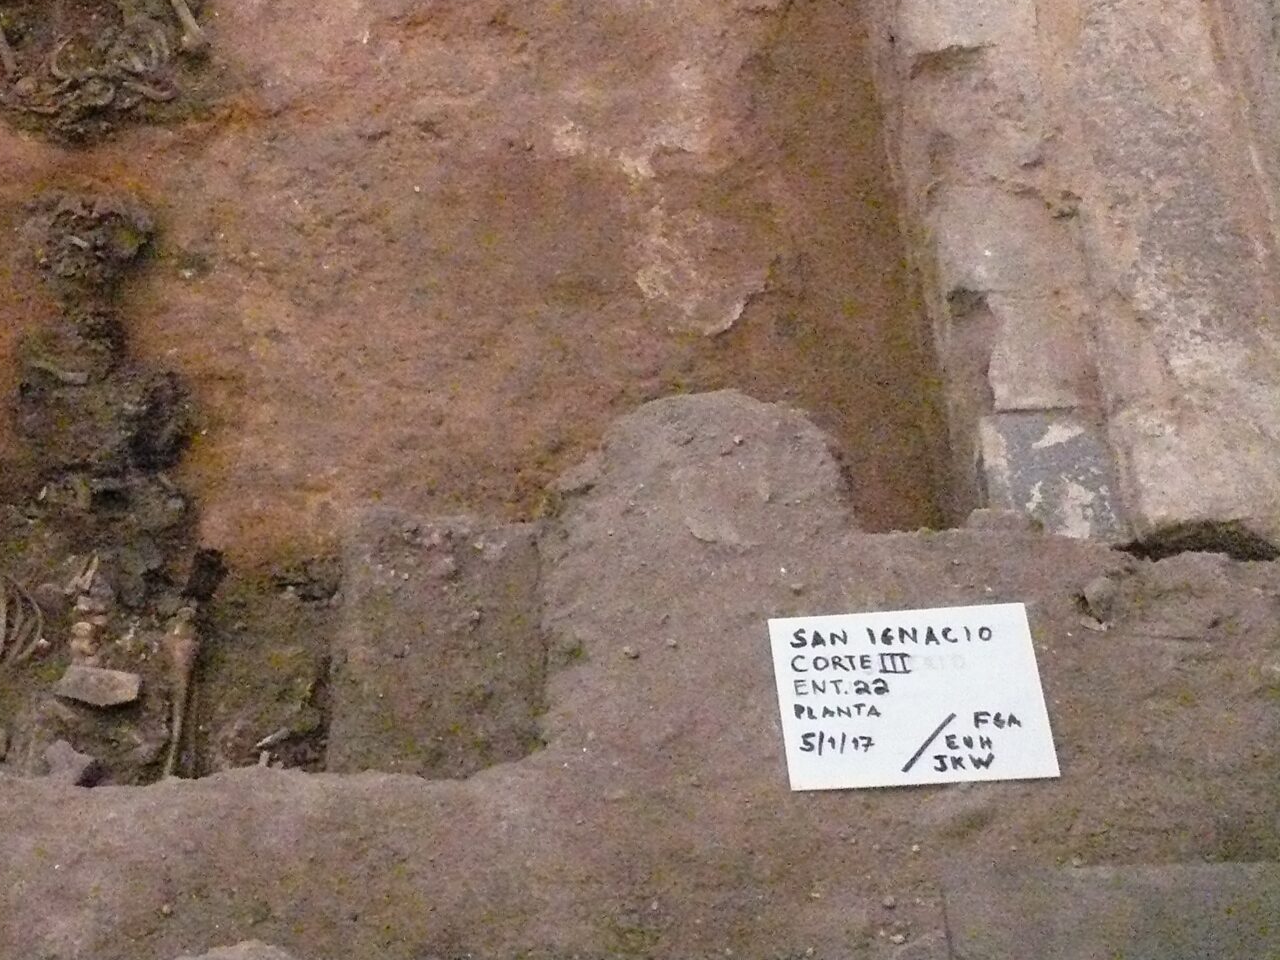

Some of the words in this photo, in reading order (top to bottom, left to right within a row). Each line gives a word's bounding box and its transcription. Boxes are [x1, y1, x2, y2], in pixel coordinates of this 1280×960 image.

[790, 627, 848, 649] SAN
[866, 626, 993, 645] IGNACIO
[791, 654, 872, 672] CORTE
[793, 703, 881, 720] PLANTA
[933, 753, 995, 772] JKW
